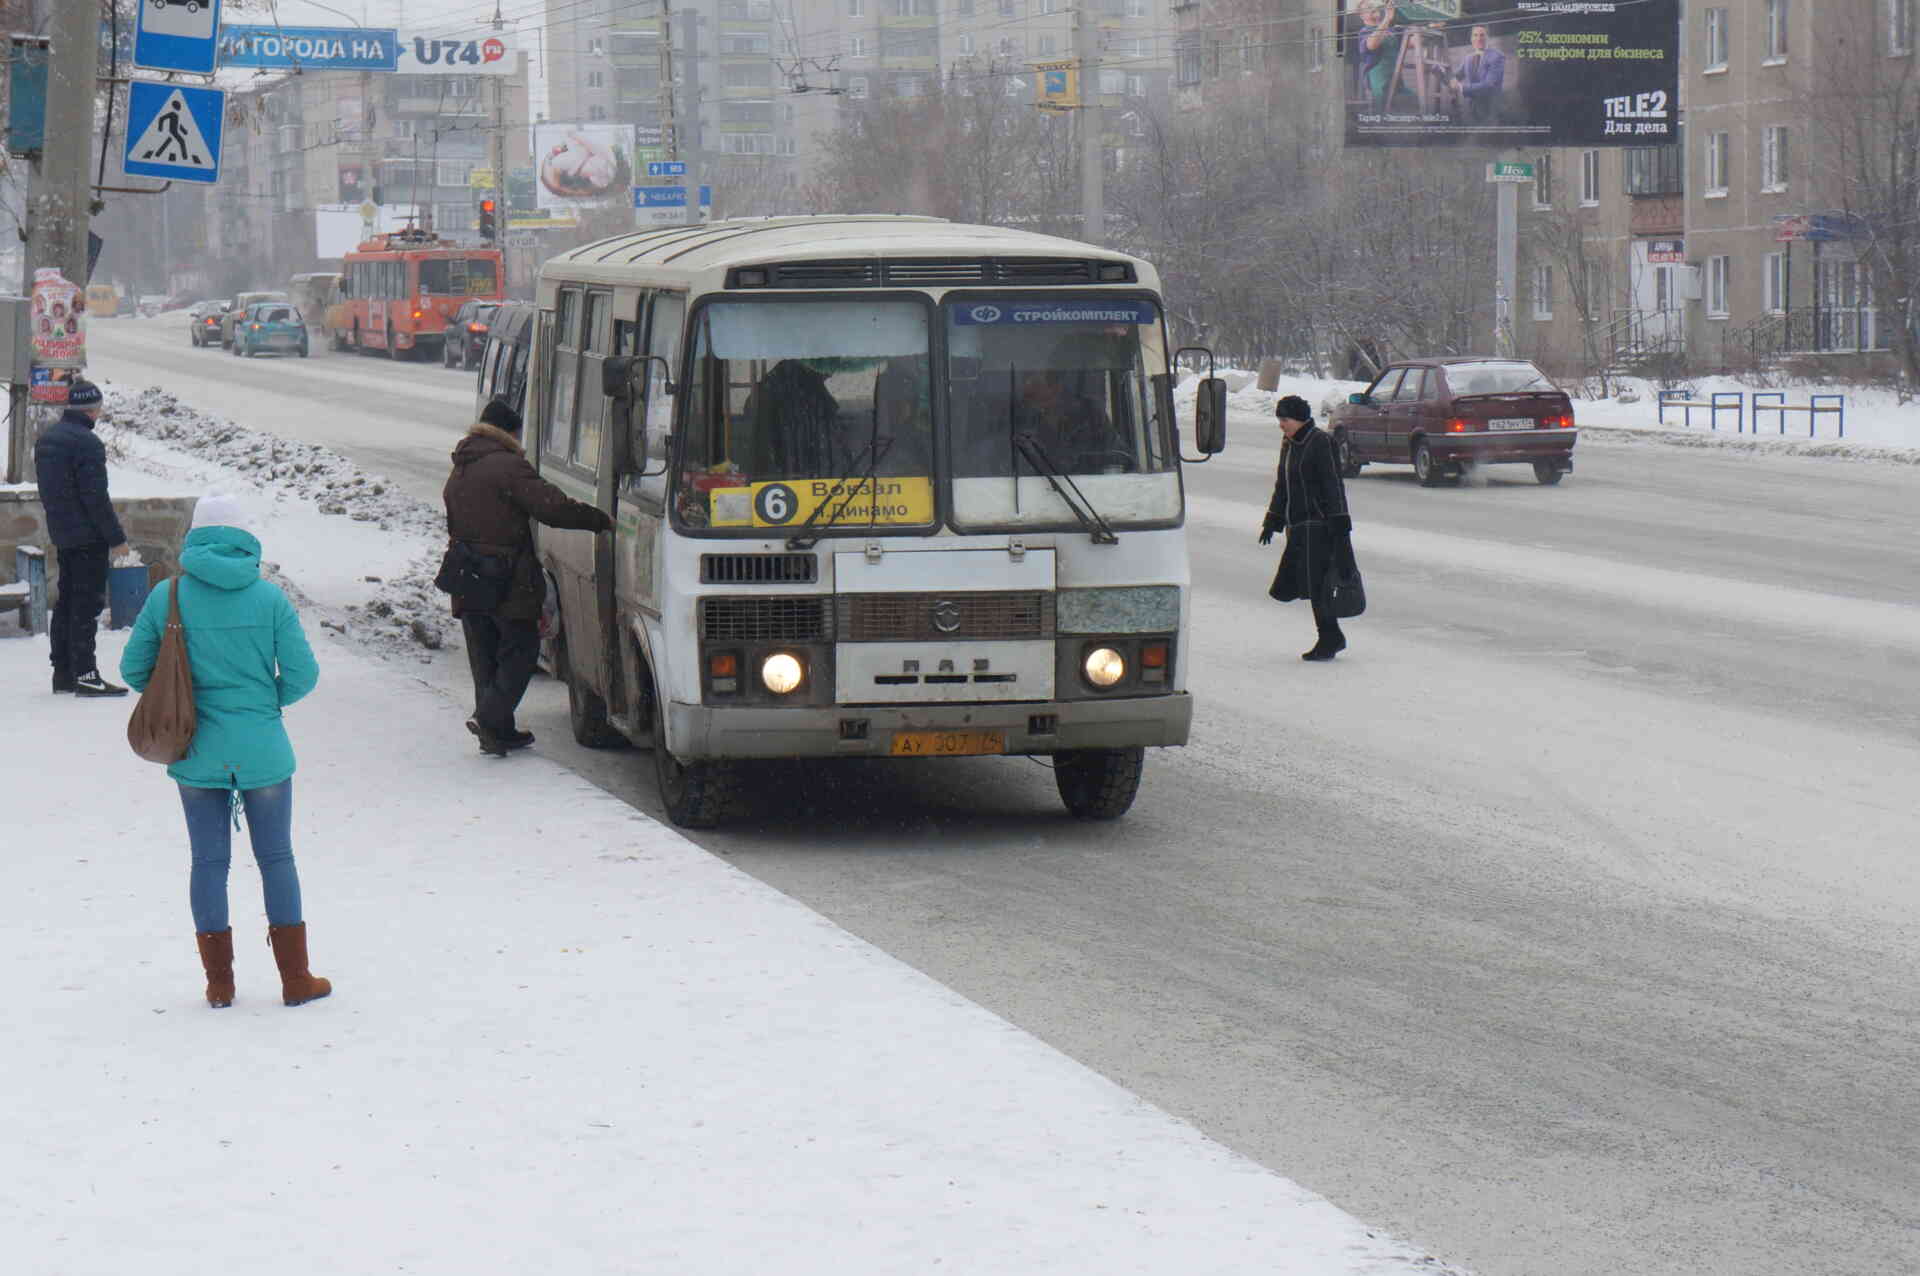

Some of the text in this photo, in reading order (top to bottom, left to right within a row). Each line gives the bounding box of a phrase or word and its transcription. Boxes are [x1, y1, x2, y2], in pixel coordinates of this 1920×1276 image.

[1519, 31, 1608, 44] 25% экономии
[253, 36, 346, 58] ГОРОДА
[352, 39, 385, 59] НА
[413, 36, 480, 65] U74
[1526, 46, 1585, 60] тарифом
[1588, 48, 1612, 60] для
[1613, 46, 1664, 59] бизнеса
[1603, 90, 1667, 117] TELE2
[1604, 120, 1668, 135] Для дела
[1013, 308, 1139, 322] СТРОЙКОМПЛЕКТ
[811, 481, 902, 497] Вокзал
[764, 488, 788, 520] 6
[903, 659, 990, 672] ПАЗ
